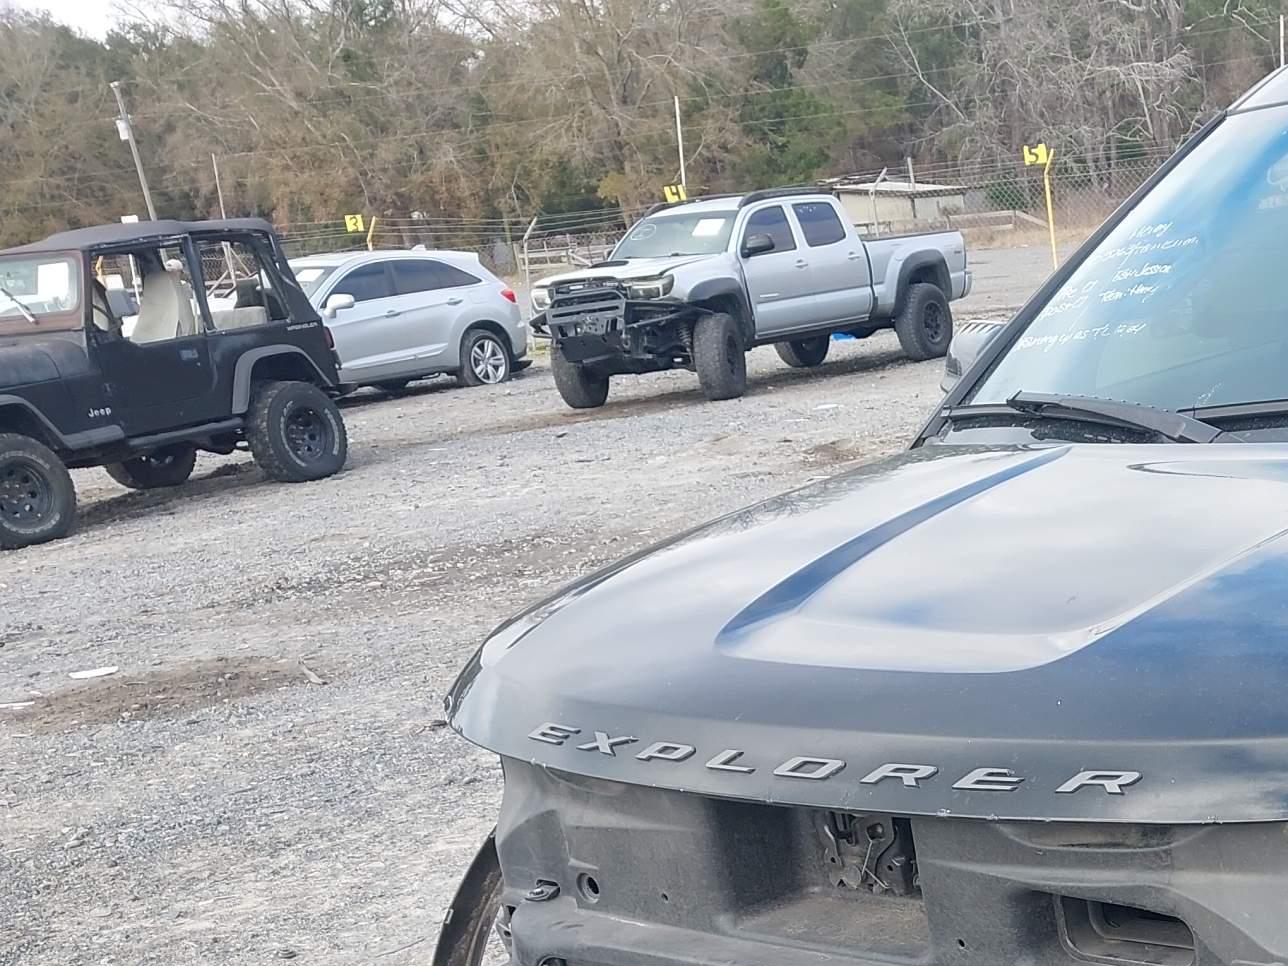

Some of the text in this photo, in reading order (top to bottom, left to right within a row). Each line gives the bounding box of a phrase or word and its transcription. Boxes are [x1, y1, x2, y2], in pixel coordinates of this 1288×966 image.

[1028, 146, 1039, 163] 5
[670, 185, 681, 200] 4
[350, 216, 358, 231] 3
[88, 407, 112, 418] Jeep
[527, 721, 1144, 796] EXPLORER
